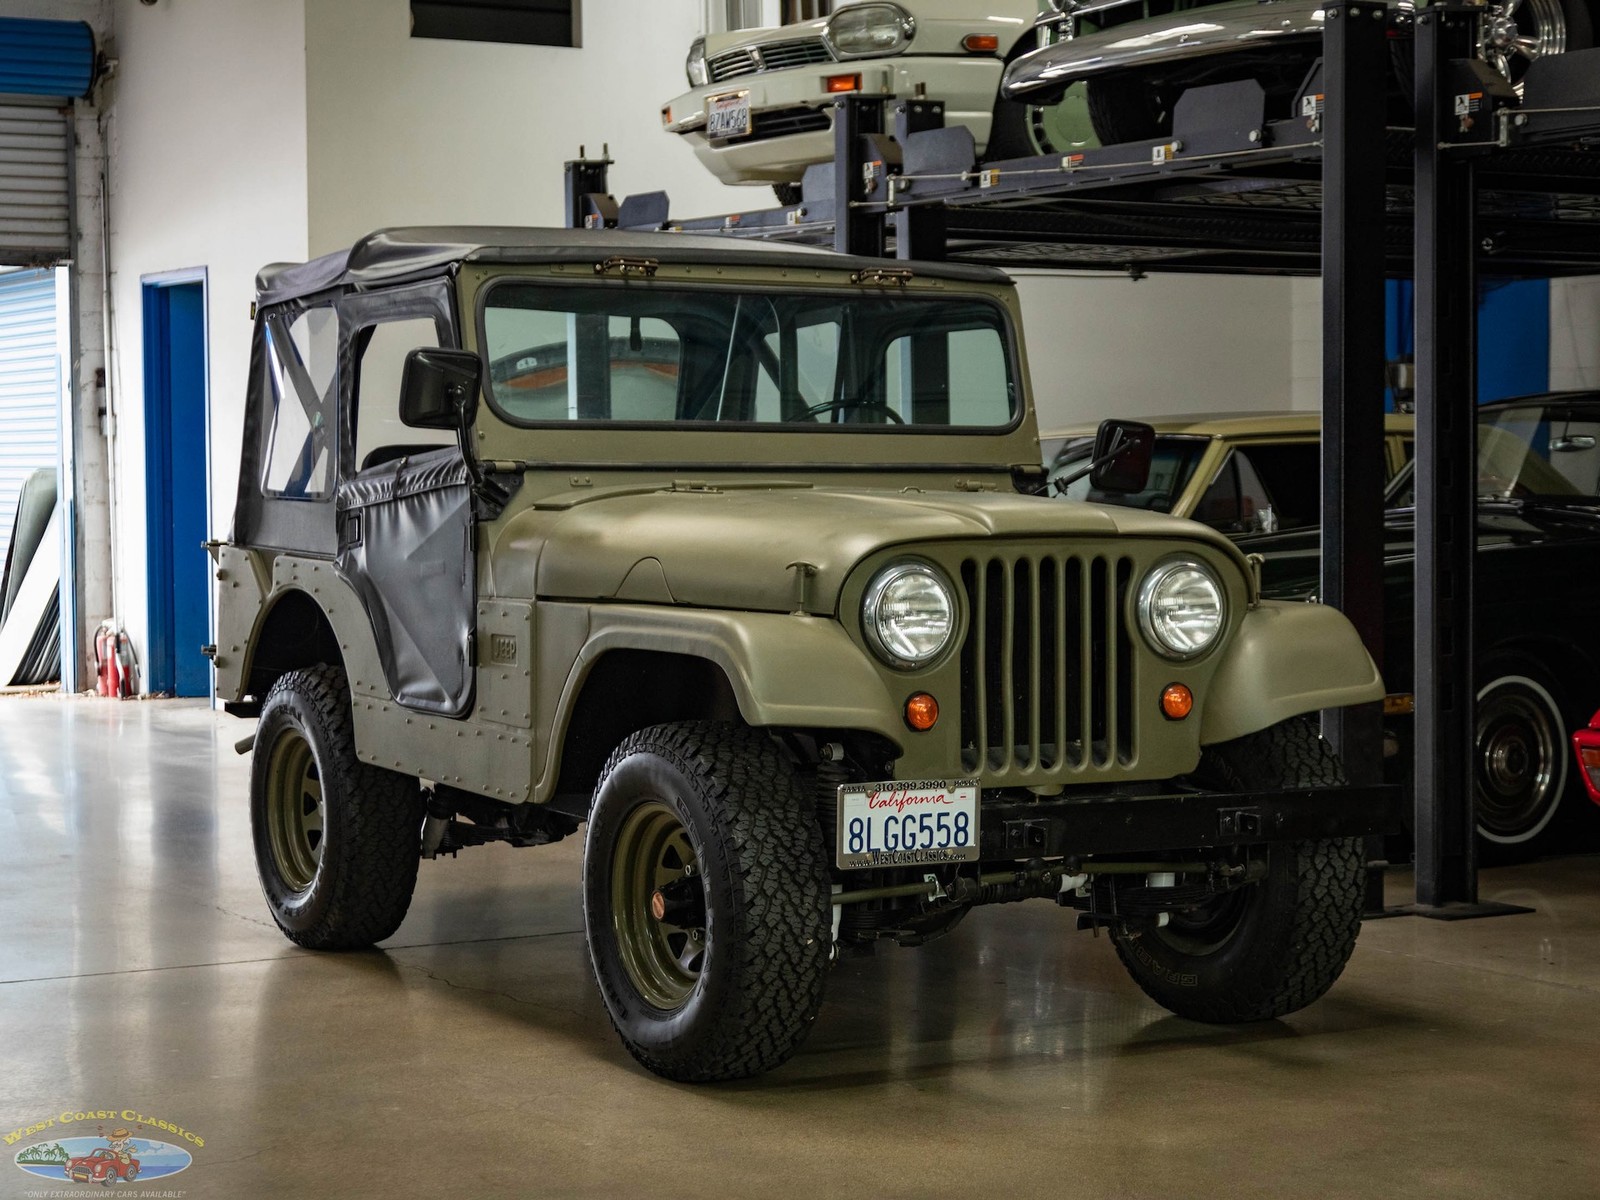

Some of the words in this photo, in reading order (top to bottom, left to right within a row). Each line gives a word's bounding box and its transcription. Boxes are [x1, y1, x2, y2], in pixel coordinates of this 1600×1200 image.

[875, 780, 947, 792] 310.399.3990
[869, 789, 954, 813] California
[849, 811, 969, 853] 8LGG558
